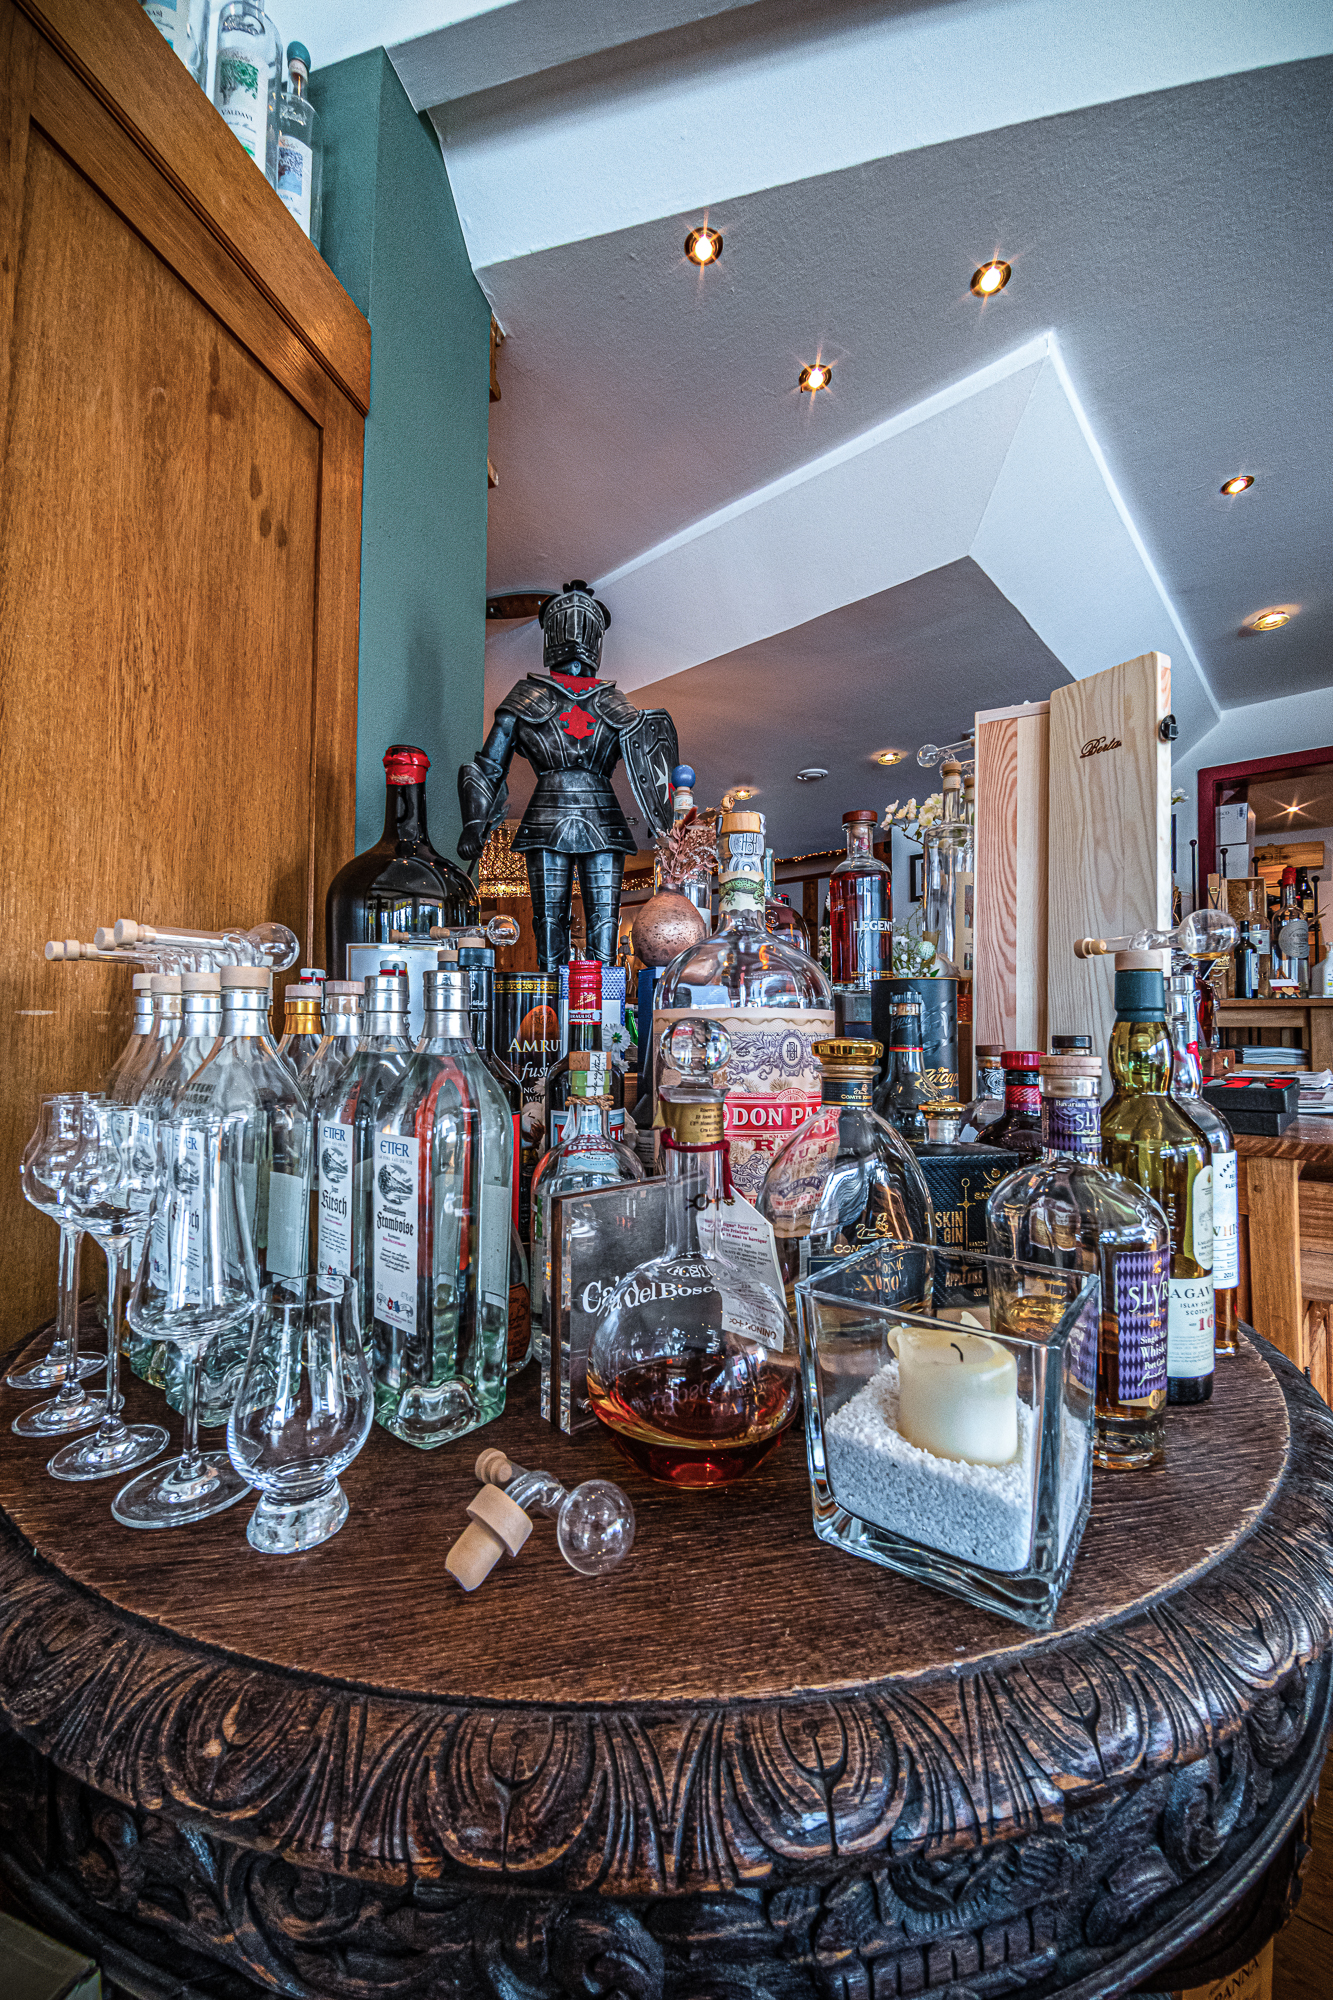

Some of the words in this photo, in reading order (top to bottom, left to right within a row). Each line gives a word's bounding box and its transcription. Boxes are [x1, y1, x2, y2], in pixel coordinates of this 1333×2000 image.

[520, 1061, 551, 1083] fusi
[924, 1068, 959, 1089] Zacap
[732, 1107, 783, 1126] DON
[790, 1107, 821, 1126] PA
[323, 1126, 346, 1141] ETTER
[380, 1140, 410, 1158] ETTER
[321, 1189, 348, 1219] Kirsch
[376, 1211, 415, 1237] Framboise
[935, 1211, 963, 1228] SKIN
[944, 1227, 963, 1244] GIN
[1212, 1223, 1237, 1237] WHI
[834, 1243, 869, 1254] COM
[1128, 1270, 1169, 1318] SLYR
[1185, 1308, 1208, 1316] SCOTCH
[1198, 1313, 1214, 1331] 16
